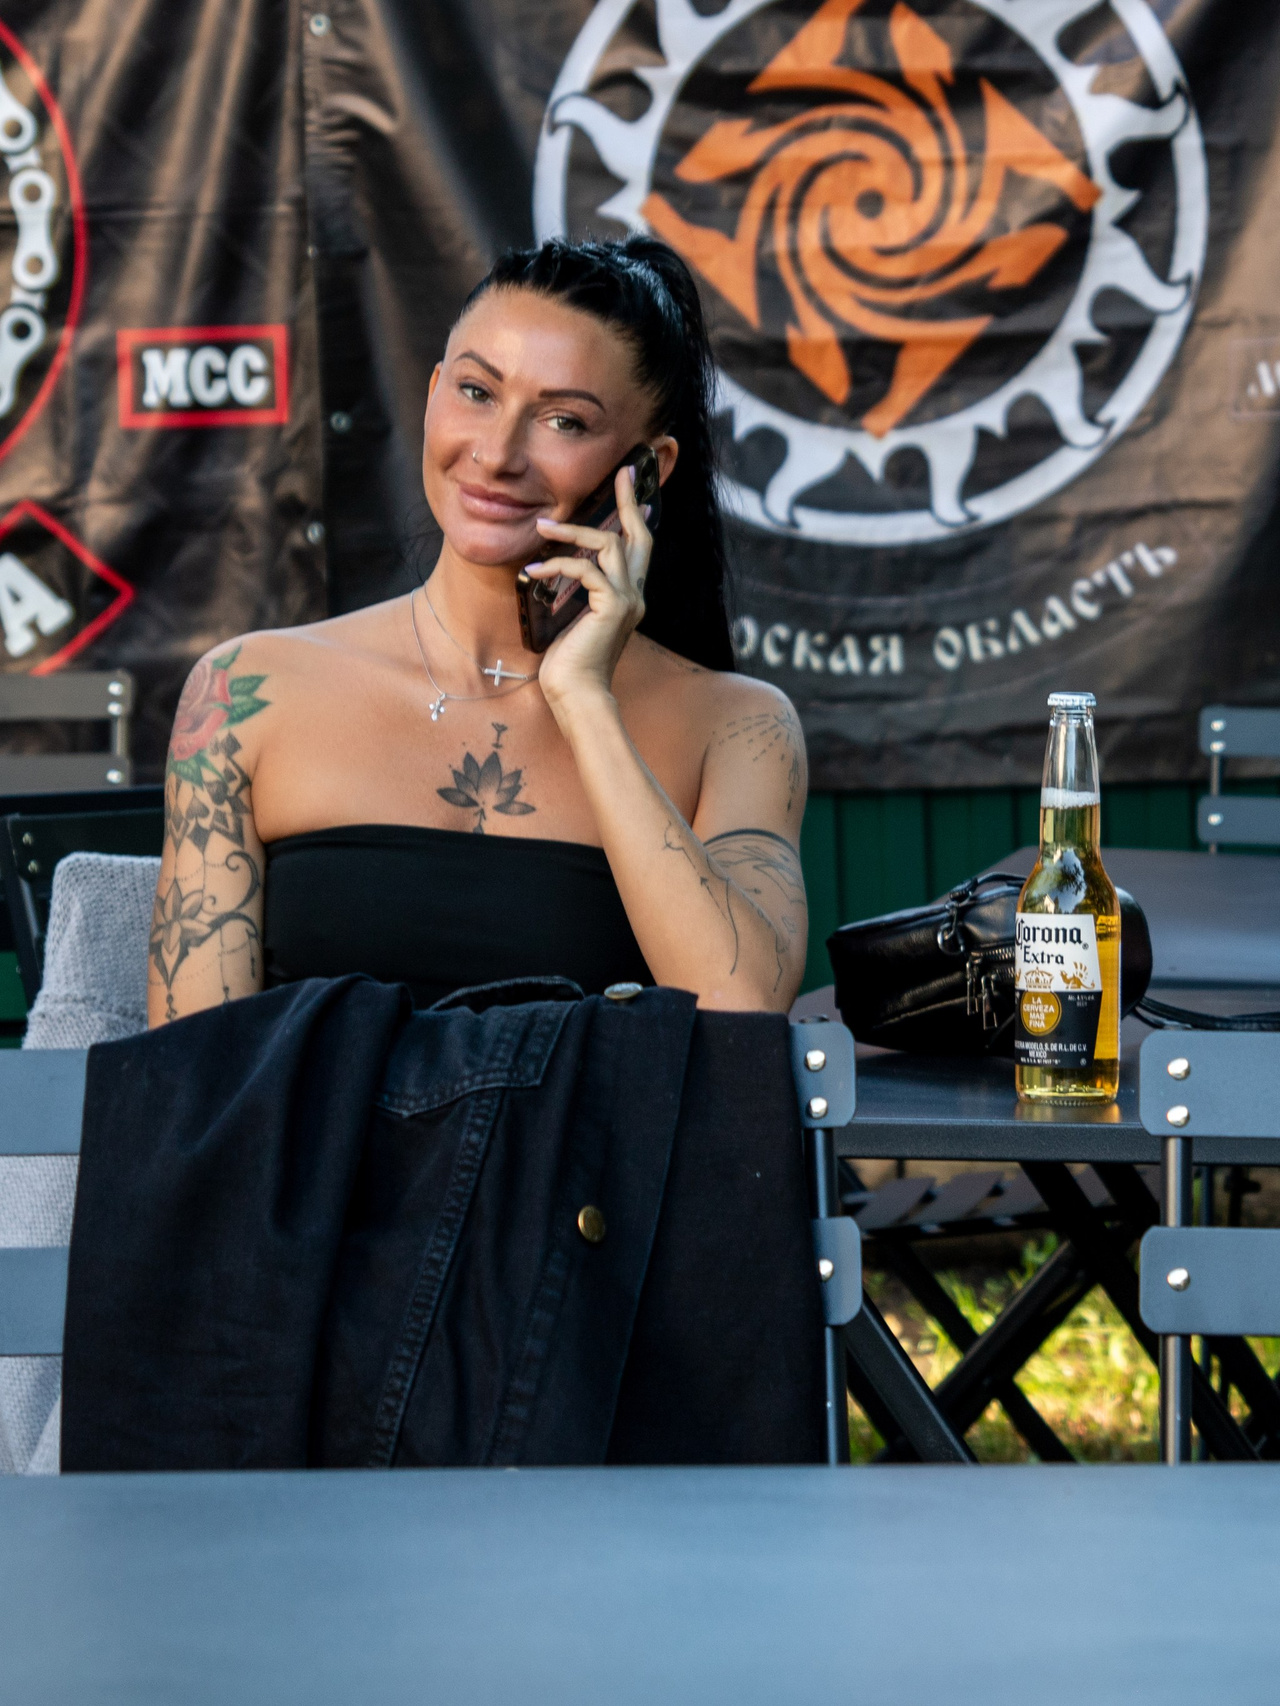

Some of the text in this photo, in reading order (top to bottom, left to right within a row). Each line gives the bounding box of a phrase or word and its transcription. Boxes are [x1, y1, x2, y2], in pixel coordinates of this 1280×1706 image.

[142, 344, 269, 408] MCC
[1015, 918, 1083, 950] Corona
[1023, 945, 1065, 965] Extra
[1031, 996, 1042, 1004] LA
[1023, 1003, 1055, 1013] CERVEZA
[1028, 1020, 1045, 1028] FINA
[1050, 1043, 1058, 1052] DE
[1069, 1043, 1077, 1052] DE
[1028, 1050, 1047, 1059] MEXICO
